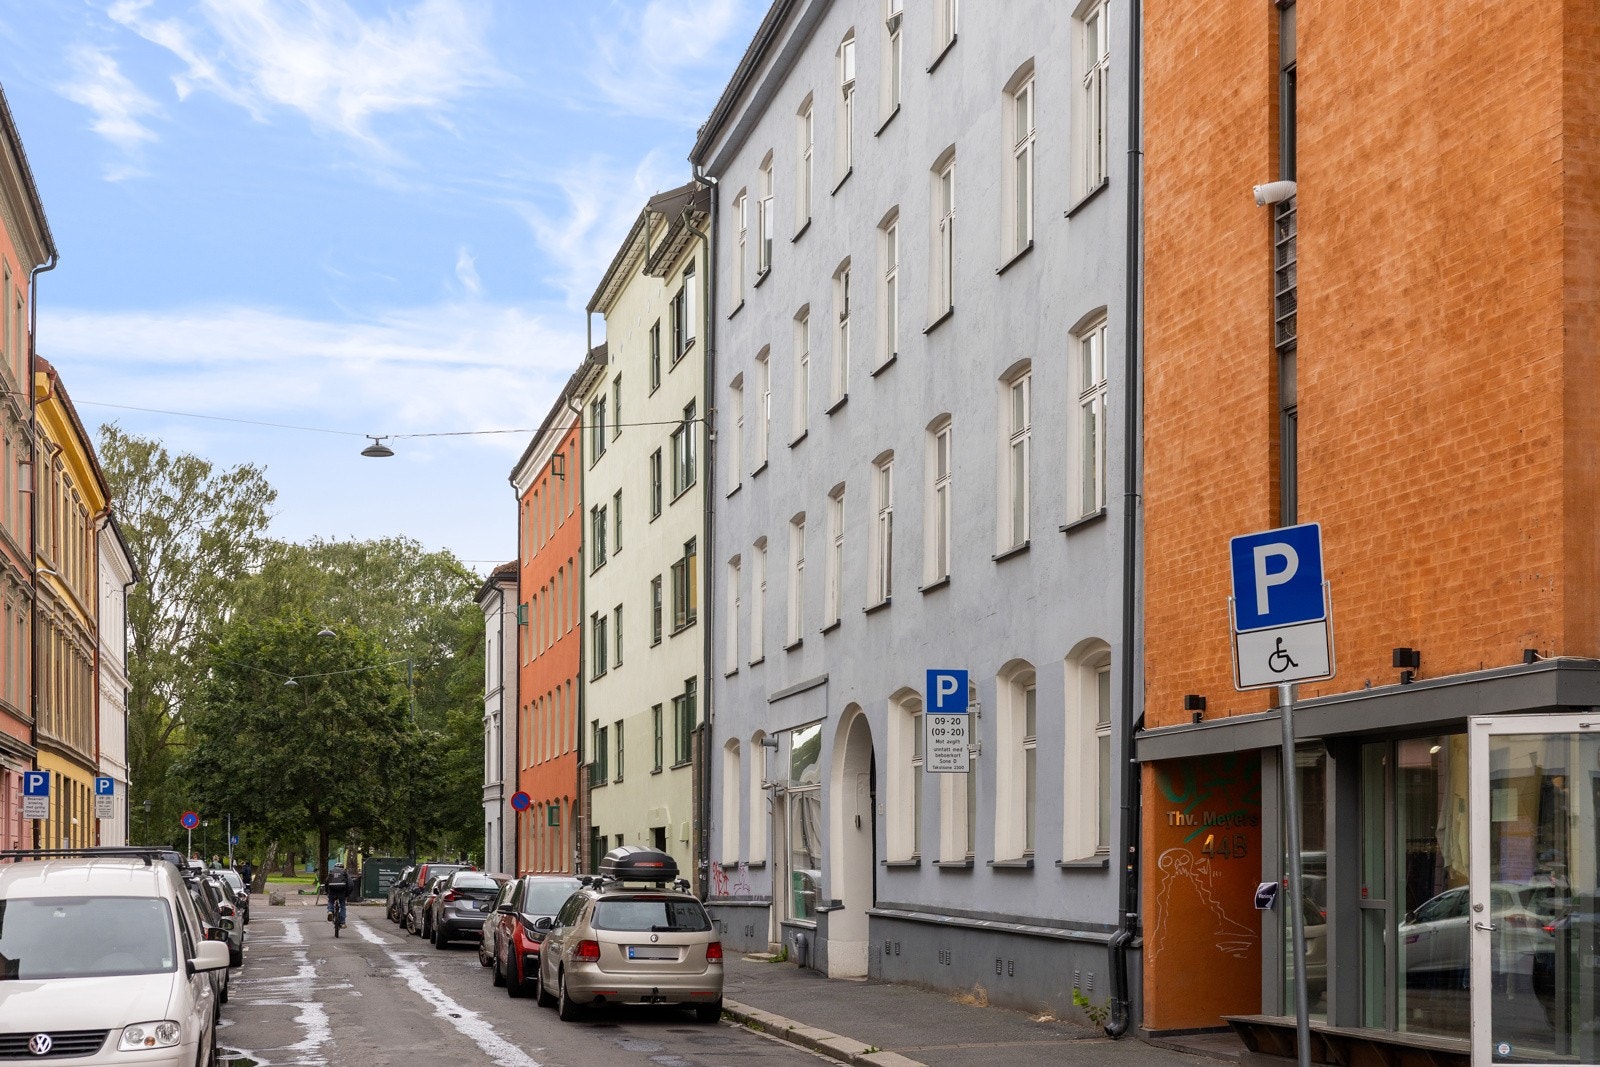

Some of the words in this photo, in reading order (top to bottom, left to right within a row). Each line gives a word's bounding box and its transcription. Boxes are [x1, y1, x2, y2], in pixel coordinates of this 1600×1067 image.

[1253, 542, 1299, 615] P
[937, 675, 958, 708] P
[29, 774, 44, 793] P
[100, 780, 110, 793] P
[1166, 811, 1198, 826] Thv.
[1202, 834, 1247, 859] 44B
